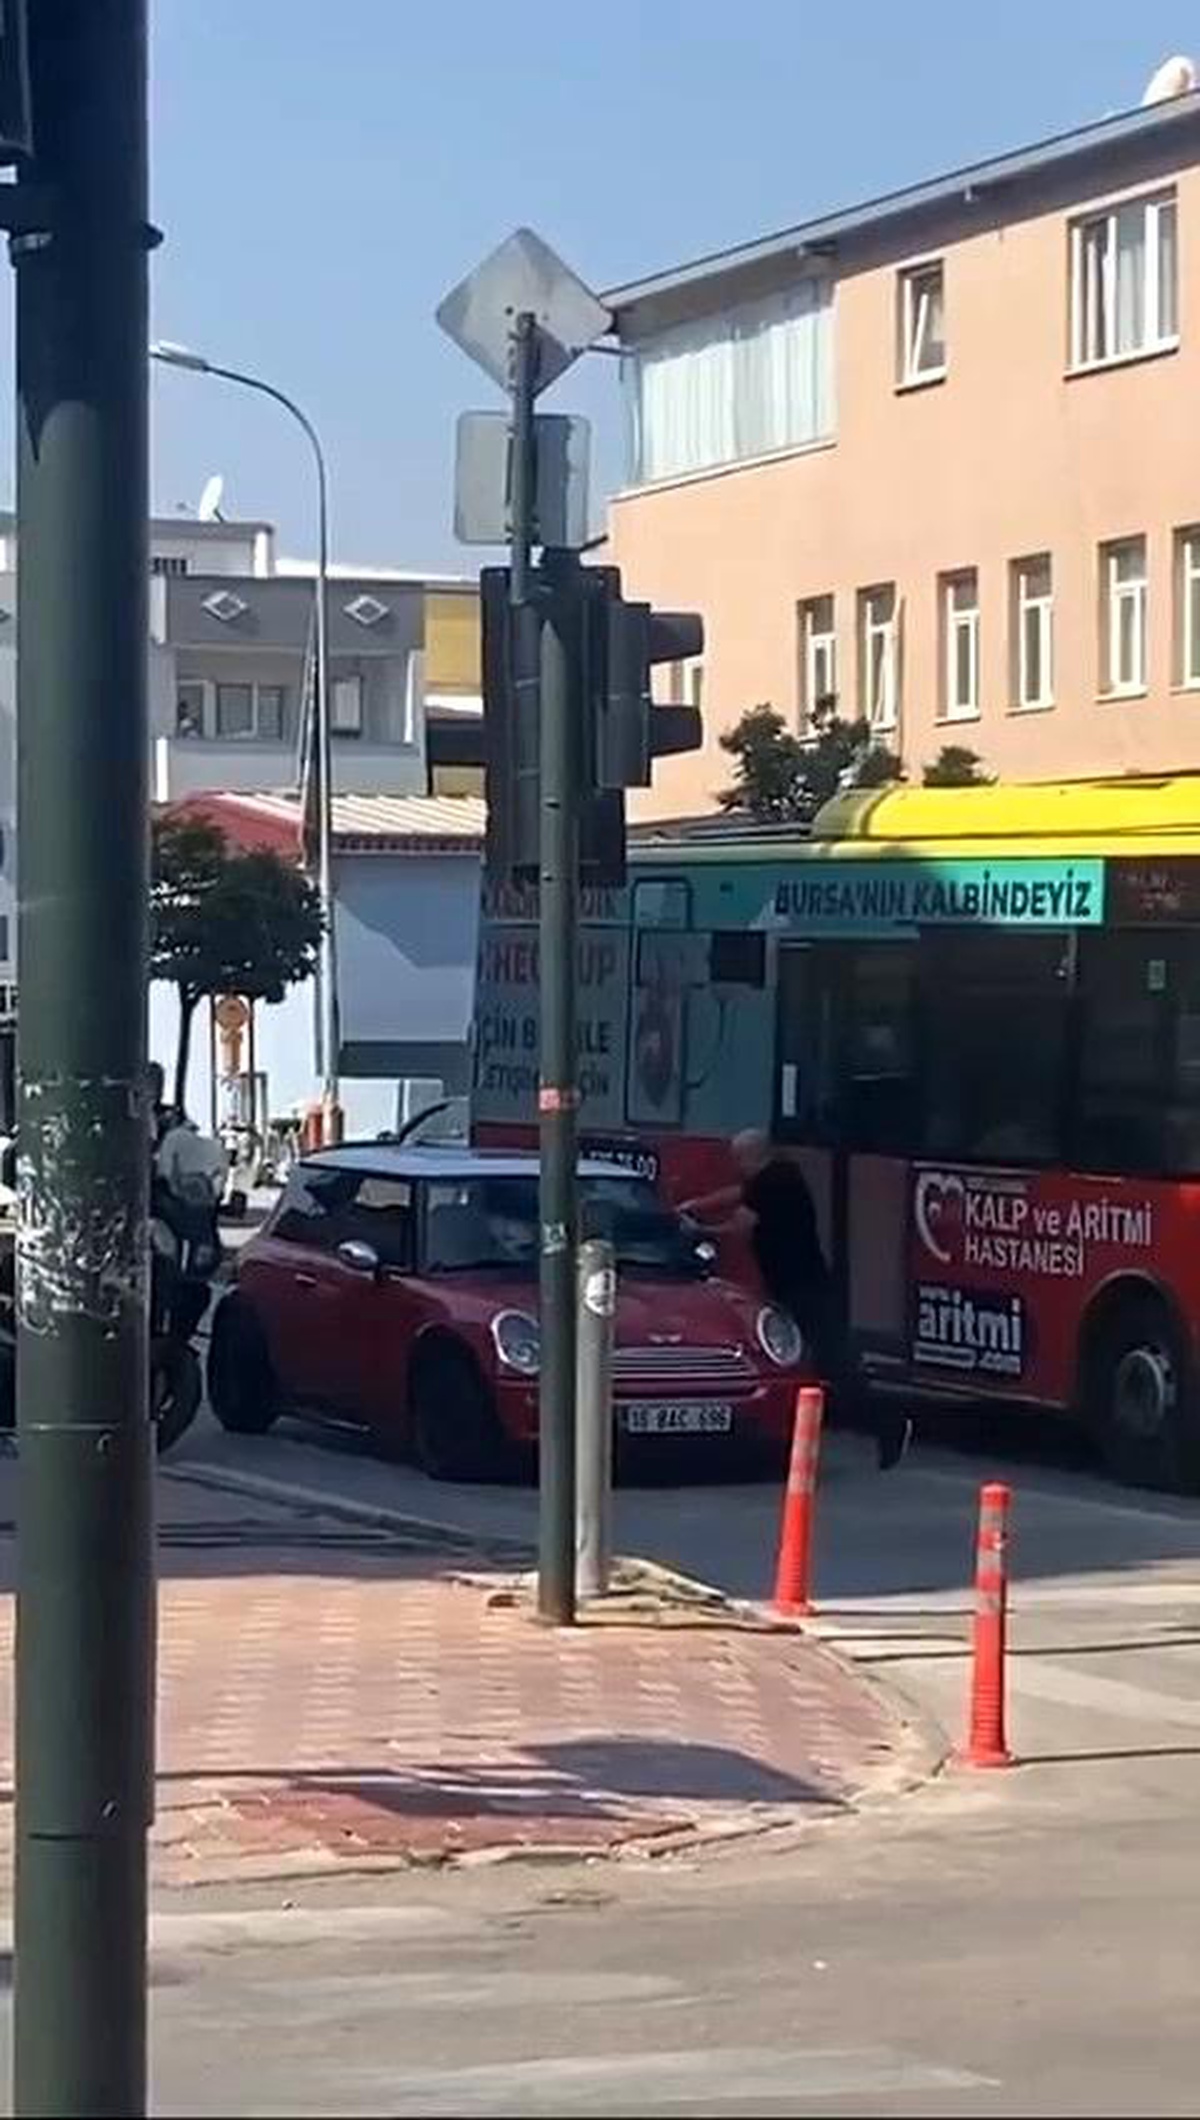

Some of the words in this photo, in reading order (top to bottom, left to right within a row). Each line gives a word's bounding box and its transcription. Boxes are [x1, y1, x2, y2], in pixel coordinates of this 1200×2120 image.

[774, 879, 902, 915] BURSA'NIN
[911, 870, 1092, 917] KALBİNDEYİZ
[966, 1192, 1027, 1231] KALP
[1033, 1208, 1060, 1235] ve
[1066, 1197, 1151, 1245] ARİTMİ
[965, 1236, 1083, 1276] HASTANESİ
[919, 1290, 1021, 1351] aritmi
